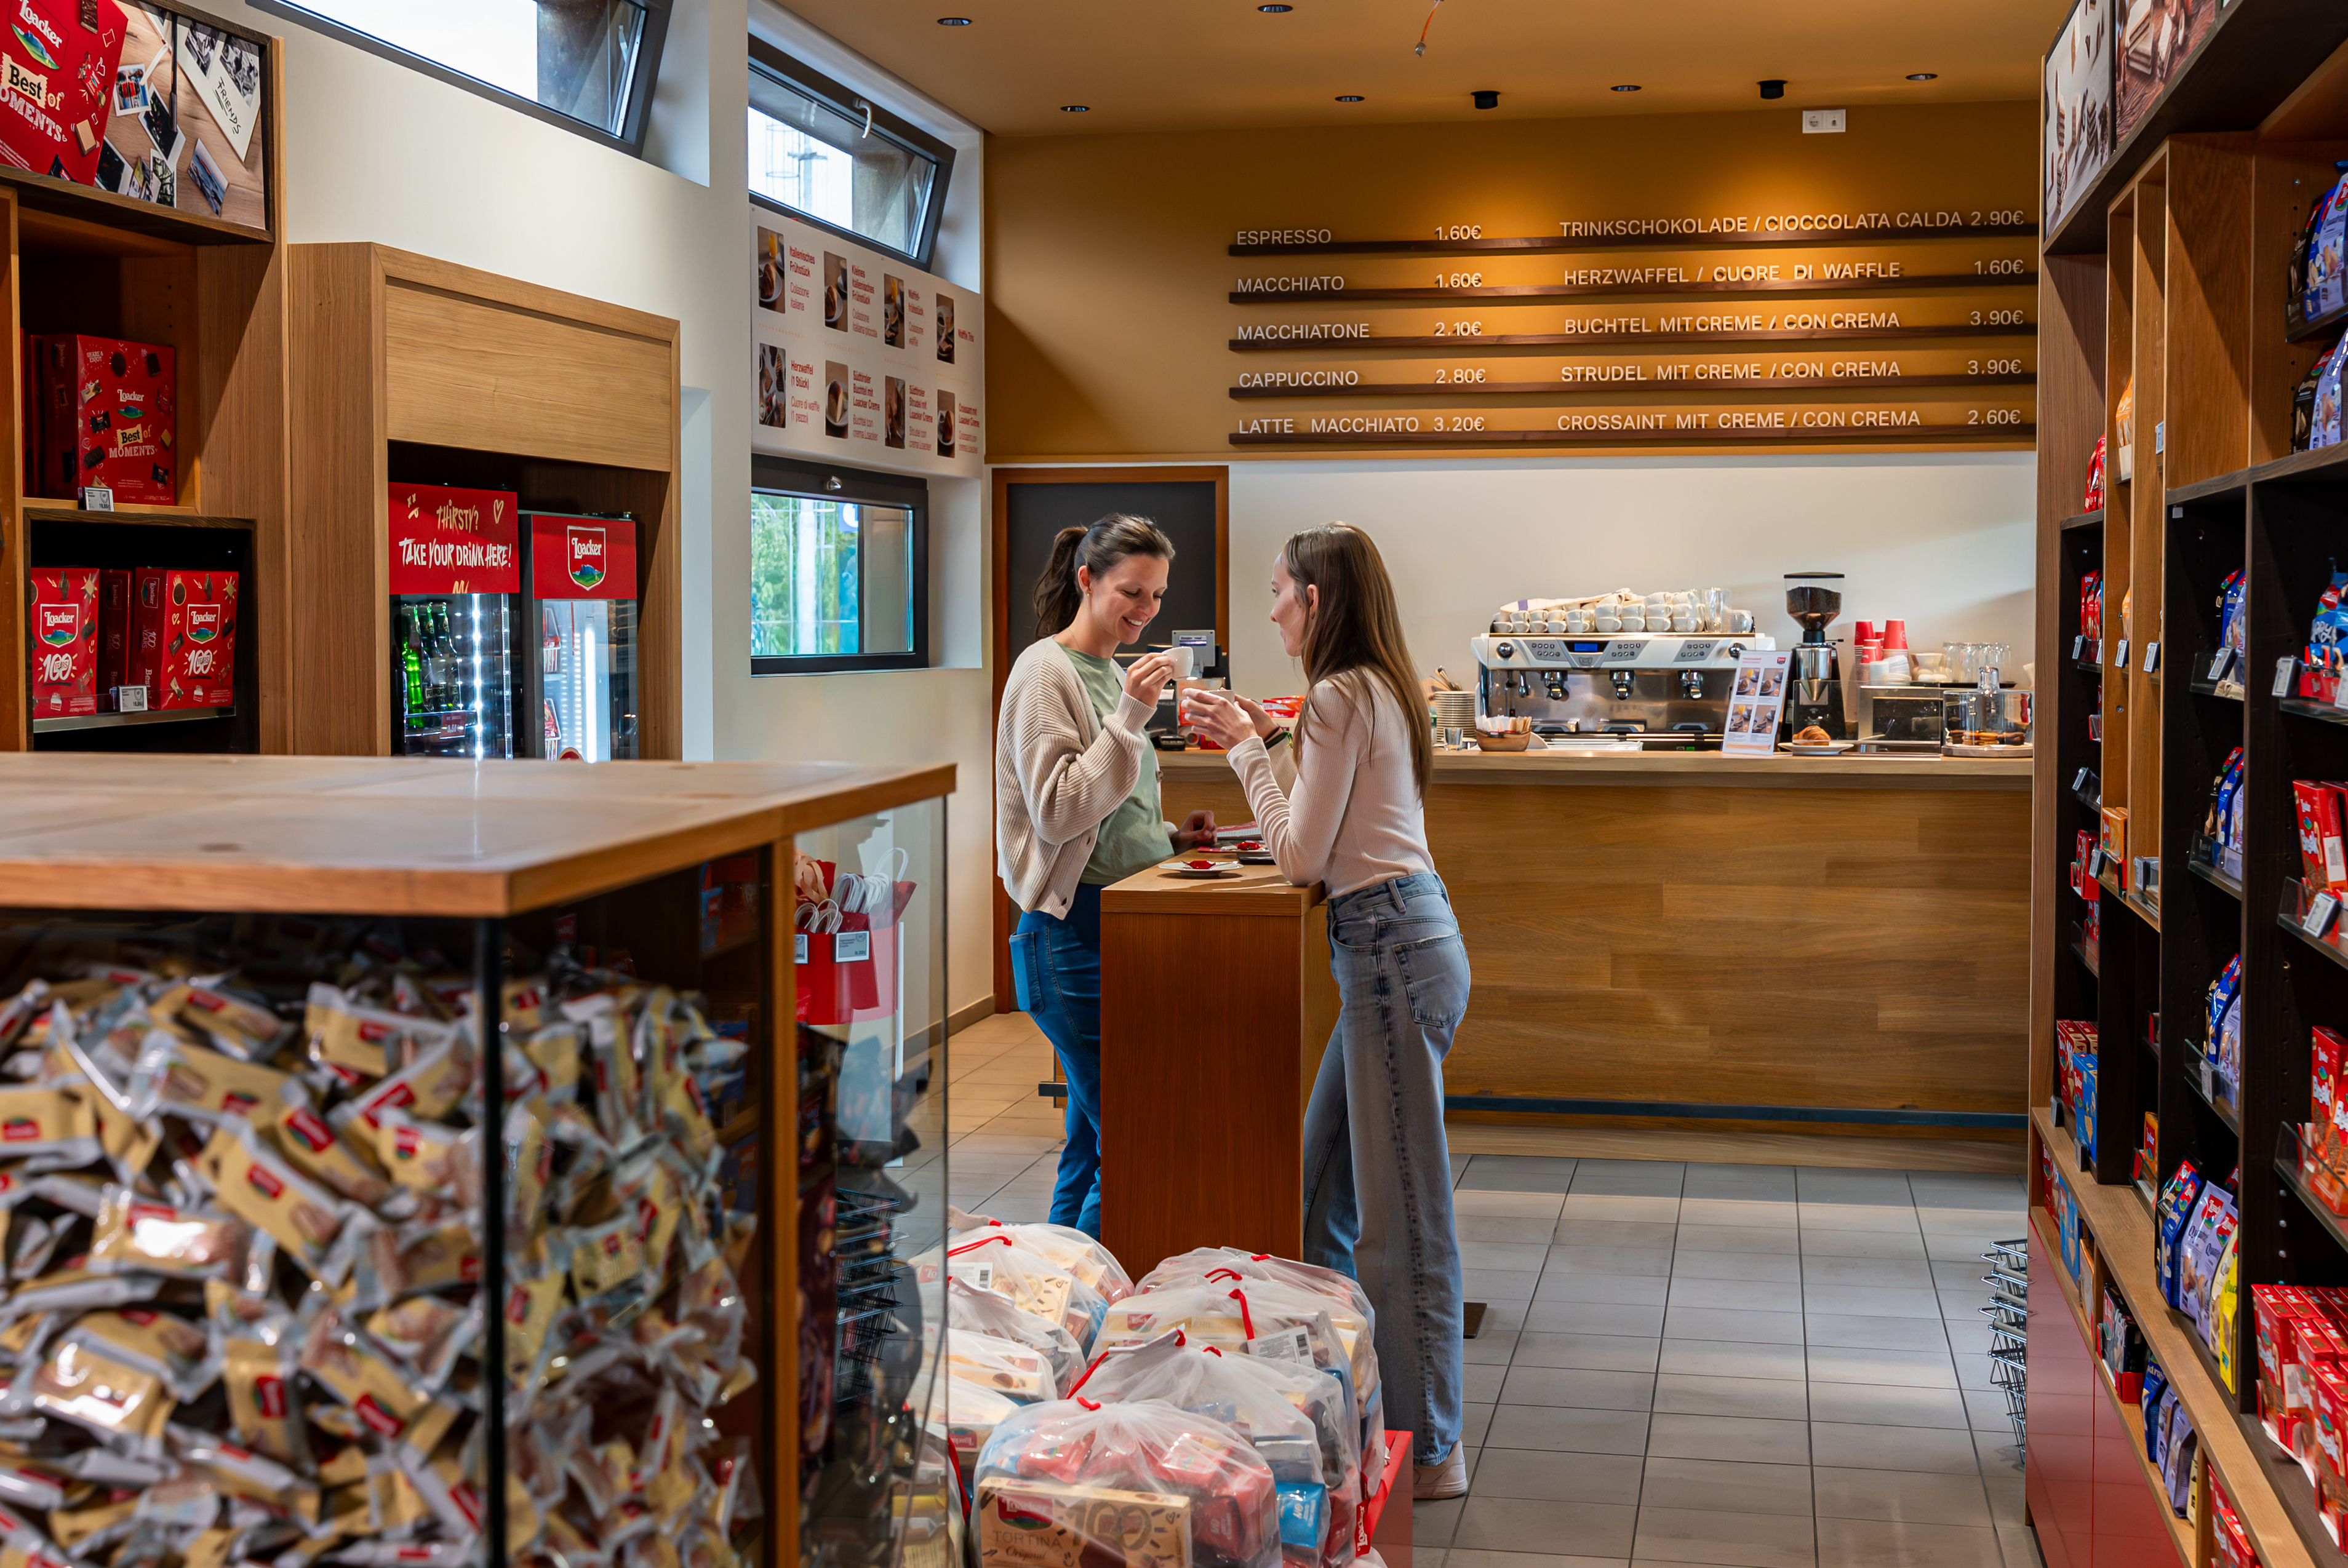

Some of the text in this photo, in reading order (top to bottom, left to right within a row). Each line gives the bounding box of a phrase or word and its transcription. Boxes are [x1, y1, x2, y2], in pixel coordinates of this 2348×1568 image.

[19, 0, 62, 49] Loacker
[9, 63, 62, 111] Best of
[217, 76, 242, 134] FRIENDS
[1560, 217, 1747, 237] TRINKSCHOKOLADE
[1753, 216, 1761, 232] /
[1764, 213, 1891, 231] CIOCCOLATA
[1896, 211, 1963, 228] CALDA
[1237, 228, 1332, 245] ESPRESSO
[1564, 266, 1690, 285] HERZWAFFEL
[1696, 266, 1704, 282] /
[1713, 265, 1780, 282] CUORE
[1794, 265, 1813, 280] DI
[1823, 262, 1901, 279] WAFFLE
[1237, 276, 1345, 293] MACCHIATO
[1238, 323, 1370, 340] MACCHIATONE
[1565, 317, 1652, 334] BUCHTEL
[1660, 316, 1693, 332] MIT
[1696, 315, 1762, 332] CREME
[1768, 315, 1776, 330] /
[1784, 314, 1826, 330] CON
[1831, 312, 1901, 328] CREMA
[1239, 370, 1359, 388] CAPPUCCINO
[1561, 365, 1647, 382] STRUDEL
[1657, 364, 1690, 381] MIT
[1695, 364, 1762, 380] CREME
[1770, 362, 1777, 378] /
[1781, 362, 1824, 378] CON
[1831, 360, 1901, 377] CREMA
[117, 389, 145, 402] Loacker
[1239, 418, 1294, 434] LATTE
[1311, 416, 1419, 433] MACCHIATO
[1557, 414, 1667, 431] CROSSAINT
[1676, 413, 1709, 429] MIT
[1718, 412, 1785, 429] CREME
[1791, 412, 1798, 428] /
[1803, 411, 1845, 427] CON
[1851, 410, 1921, 427] CREMA
[121, 430, 141, 444] Best
[109, 445, 155, 458] MOMENTS
[399, 537, 426, 567] TAKE
[429, 538, 457, 571] YOUR
[571, 537, 602, 559] Loacker
[44, 611, 74, 627] Loacker
[191, 611, 217, 624] Loacker
[42, 653, 73, 683] 100
[188, 650, 212, 676] 100
[1356, 1505, 1368, 1551] Loacker
[993, 1530, 1063, 1549] TORTINA
